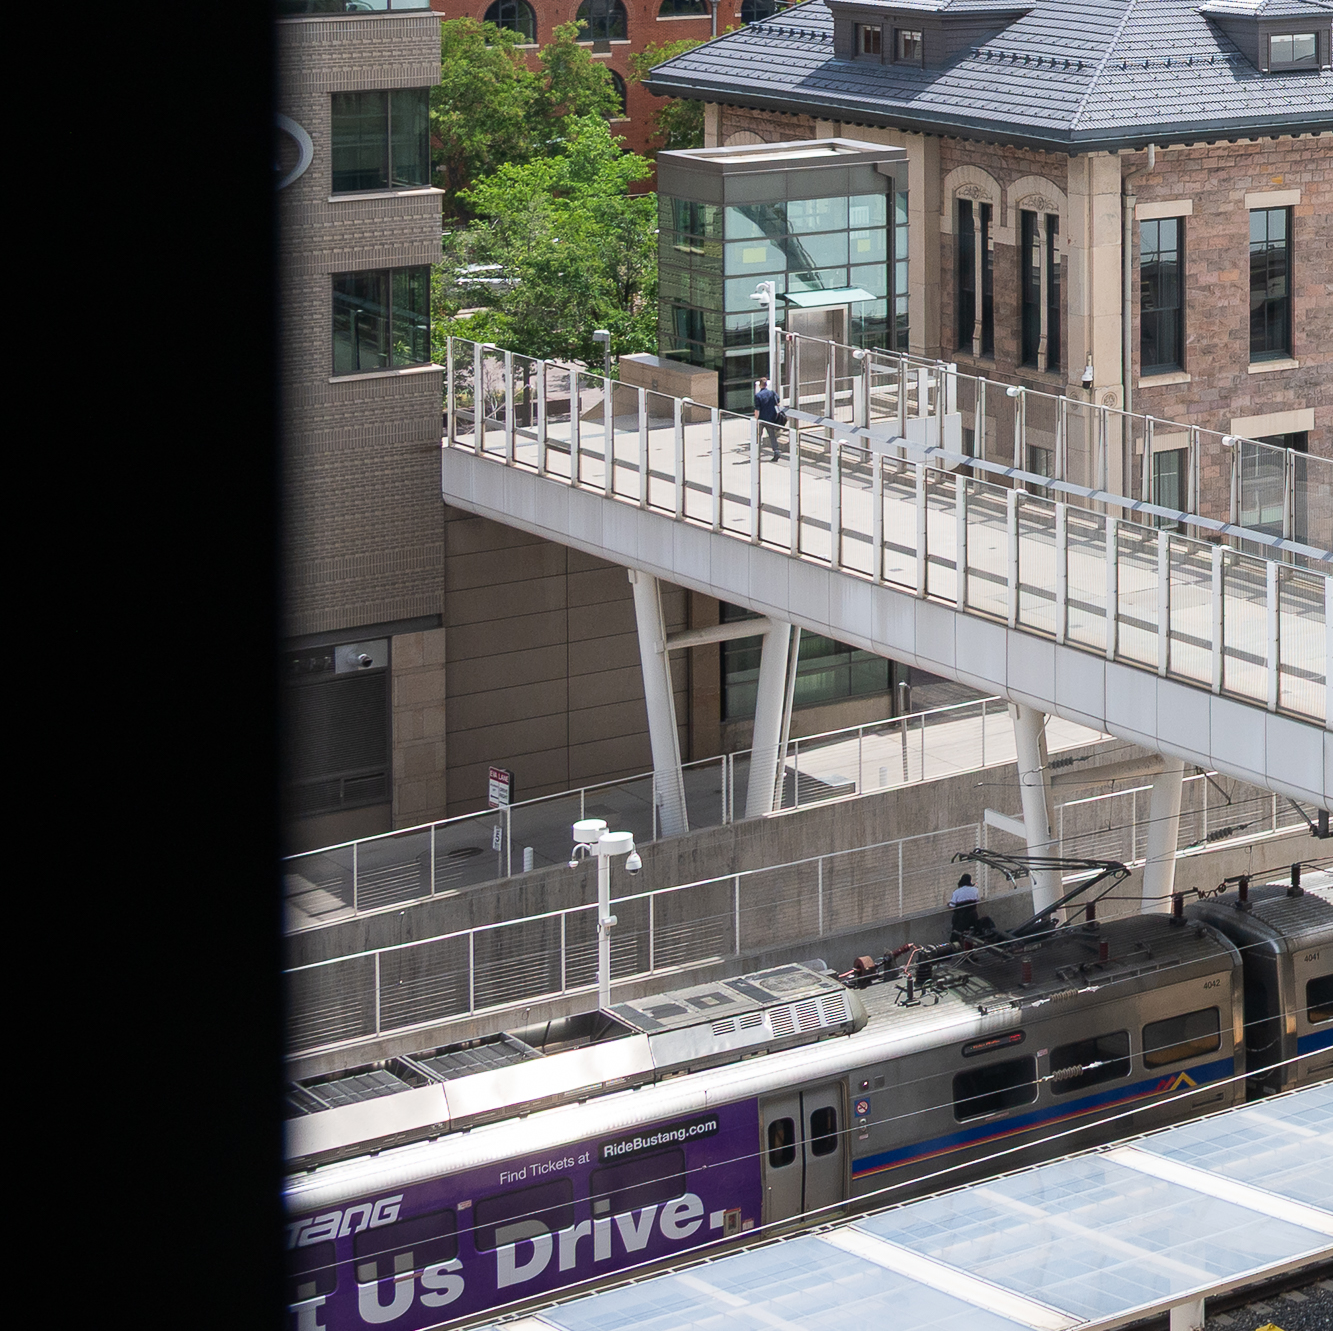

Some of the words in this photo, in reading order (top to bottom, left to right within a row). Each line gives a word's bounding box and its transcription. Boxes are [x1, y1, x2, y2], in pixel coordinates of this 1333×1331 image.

[1304, 952, 1320, 963] 4041
[1203, 979, 1221, 990] 4042
[499, 1166, 527, 1185] Find
[529, 1156, 575, 1177] Tickets
[577, 1150, 591, 1164] at
[603, 1118, 718, 1159] RideBustang.com
[357, 1251, 465, 1325] Us
[494, 1192, 727, 1290] Drive.
